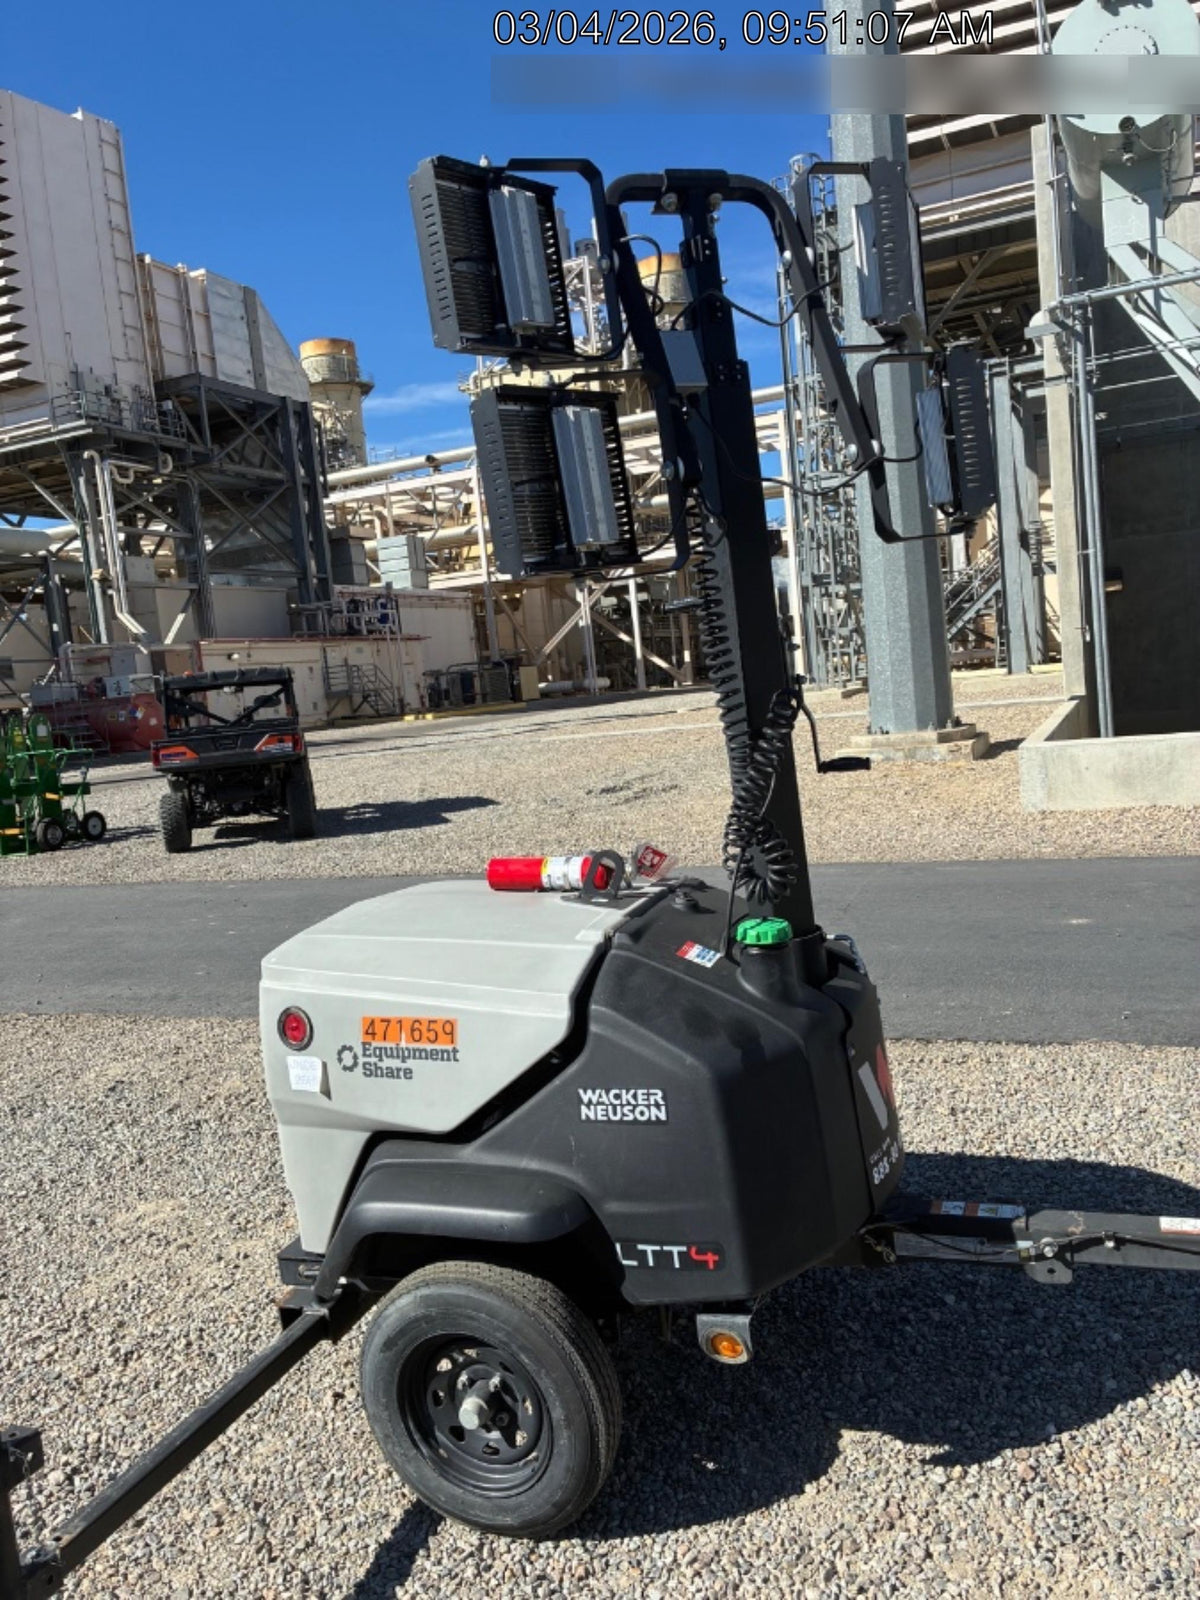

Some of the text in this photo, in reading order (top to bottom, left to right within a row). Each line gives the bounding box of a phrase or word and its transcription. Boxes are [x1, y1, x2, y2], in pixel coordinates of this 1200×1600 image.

[364, 1018, 455, 1045] 471659
[361, 1042, 460, 1064] Equipment
[362, 1063, 413, 1080] Share
[578, 1088, 666, 1105] WACKER
[580, 1105, 667, 1121] NEUSON
